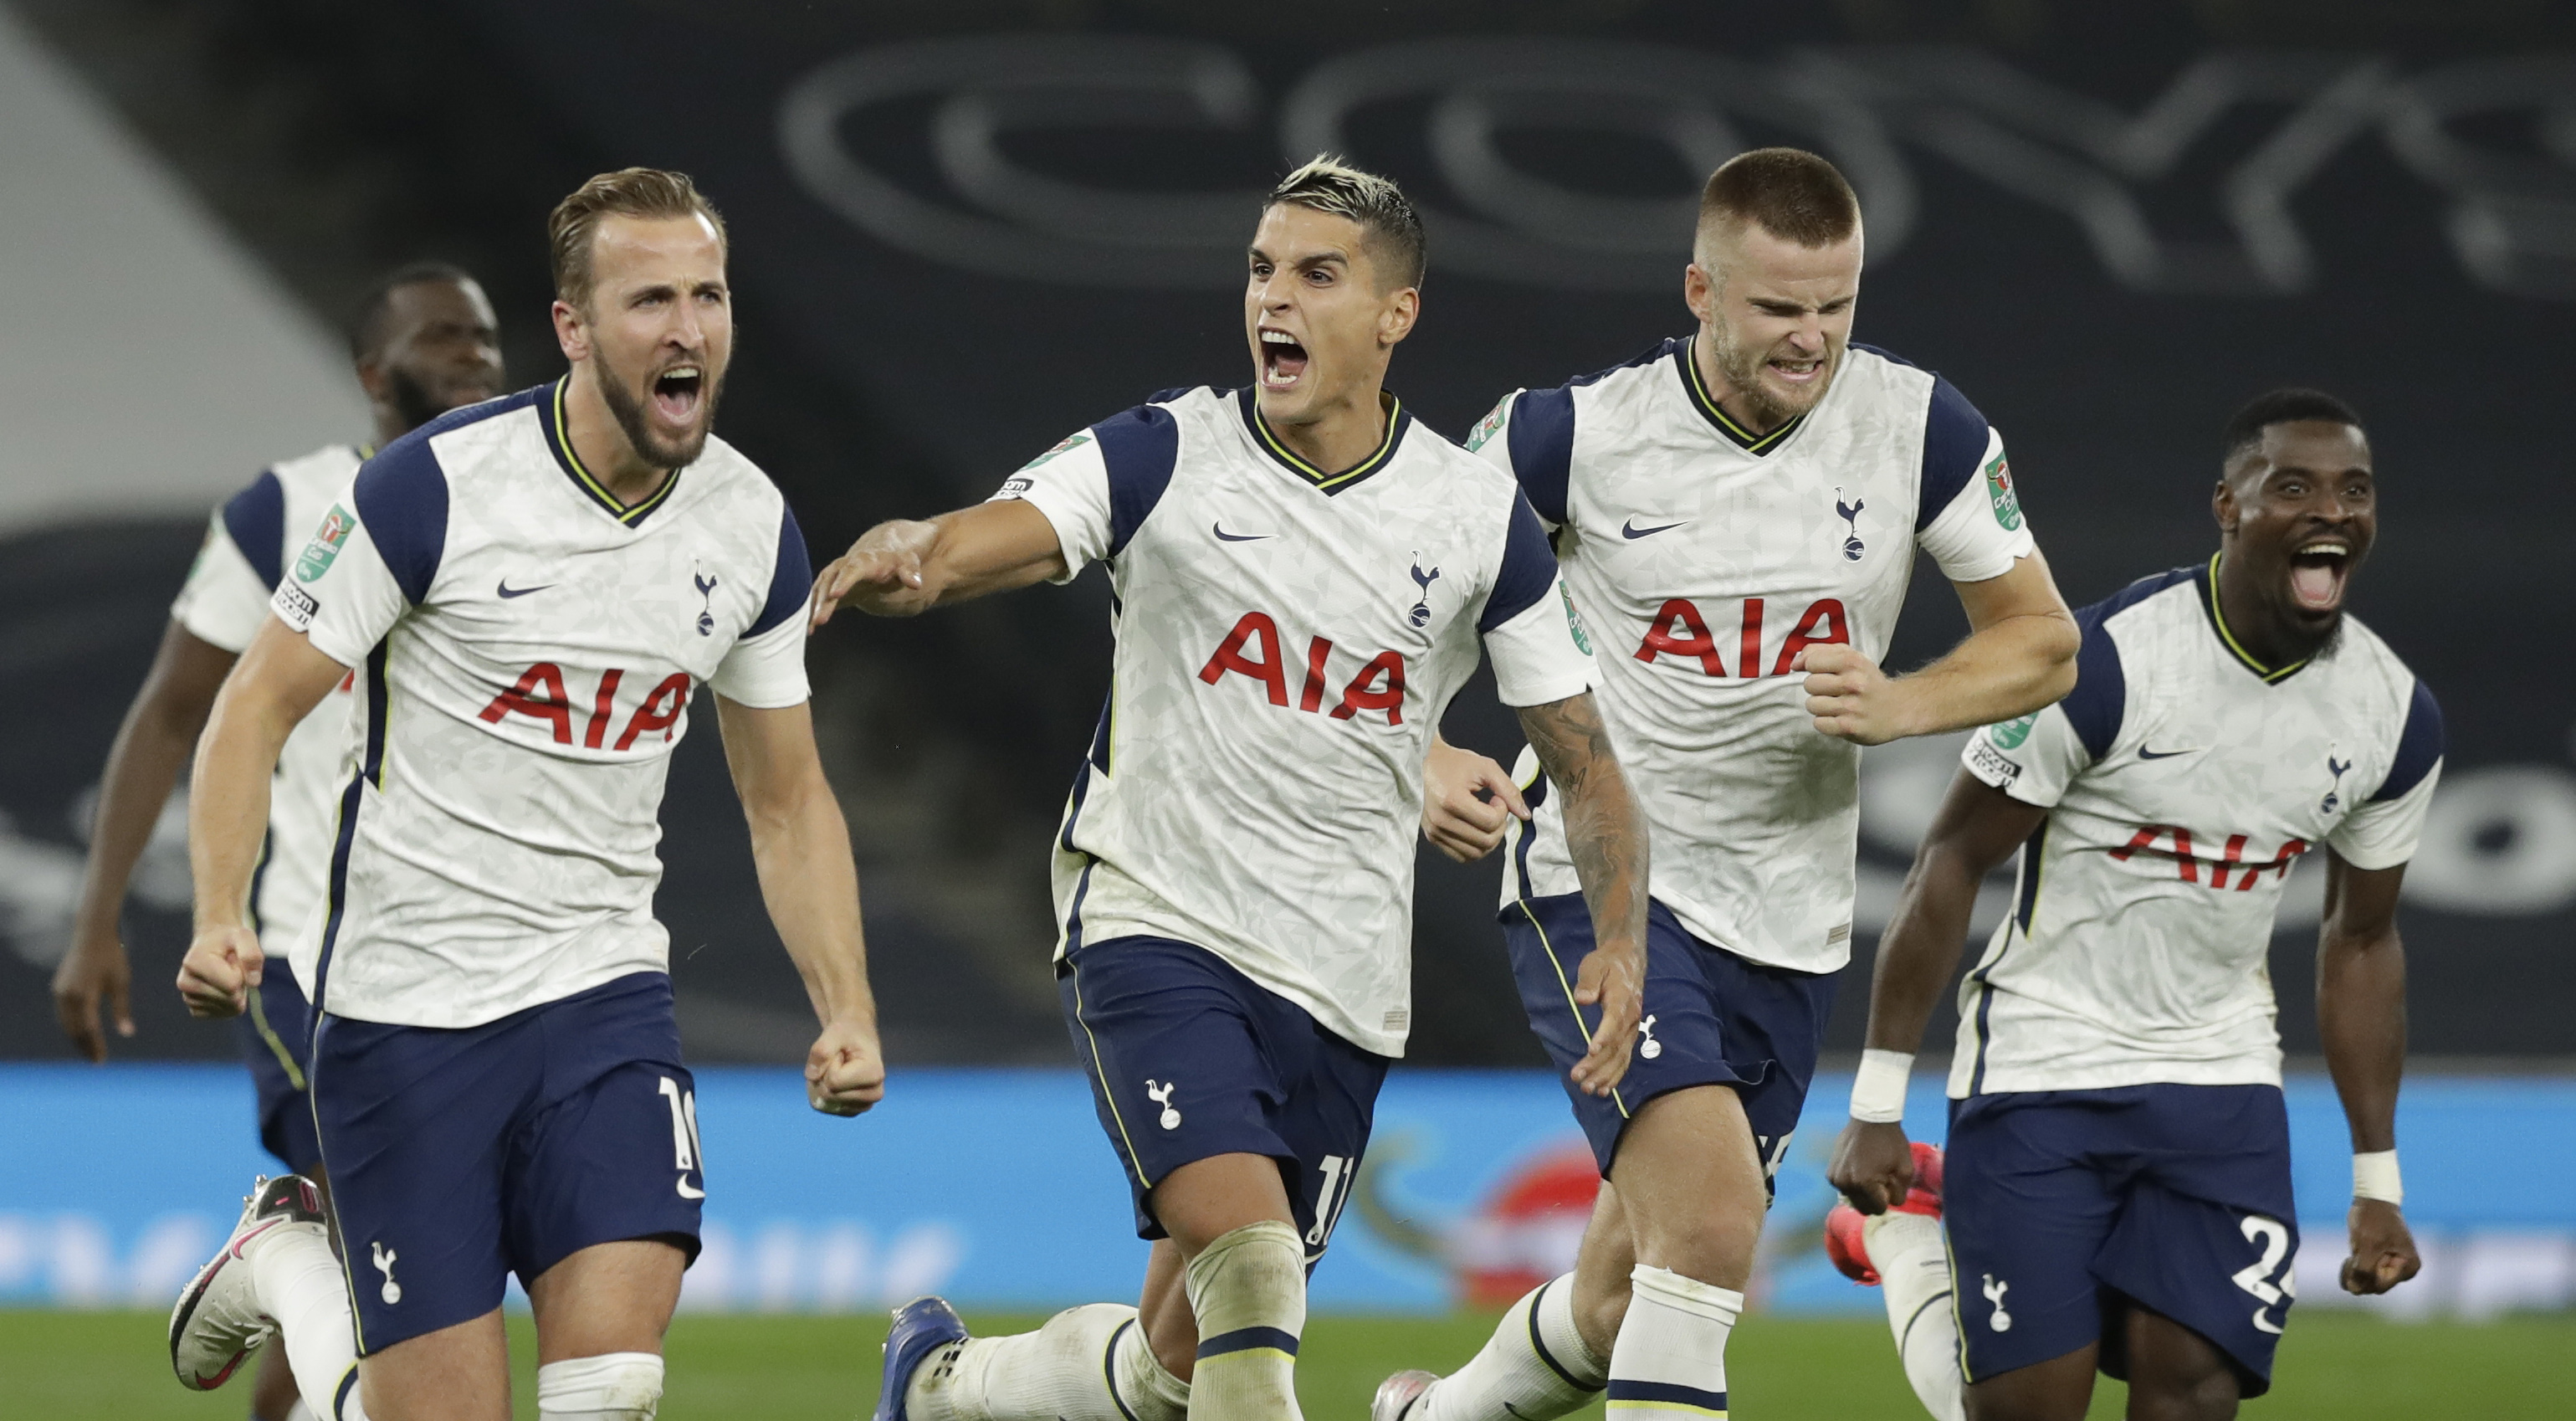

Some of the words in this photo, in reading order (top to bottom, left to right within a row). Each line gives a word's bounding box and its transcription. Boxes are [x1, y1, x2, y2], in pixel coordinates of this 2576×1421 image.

[1198, 611, 1406, 726] AIA
[1633, 598, 1849, 679] AIA
[478, 661, 689, 751] AIA
[2107, 823, 2305, 892] AIA
